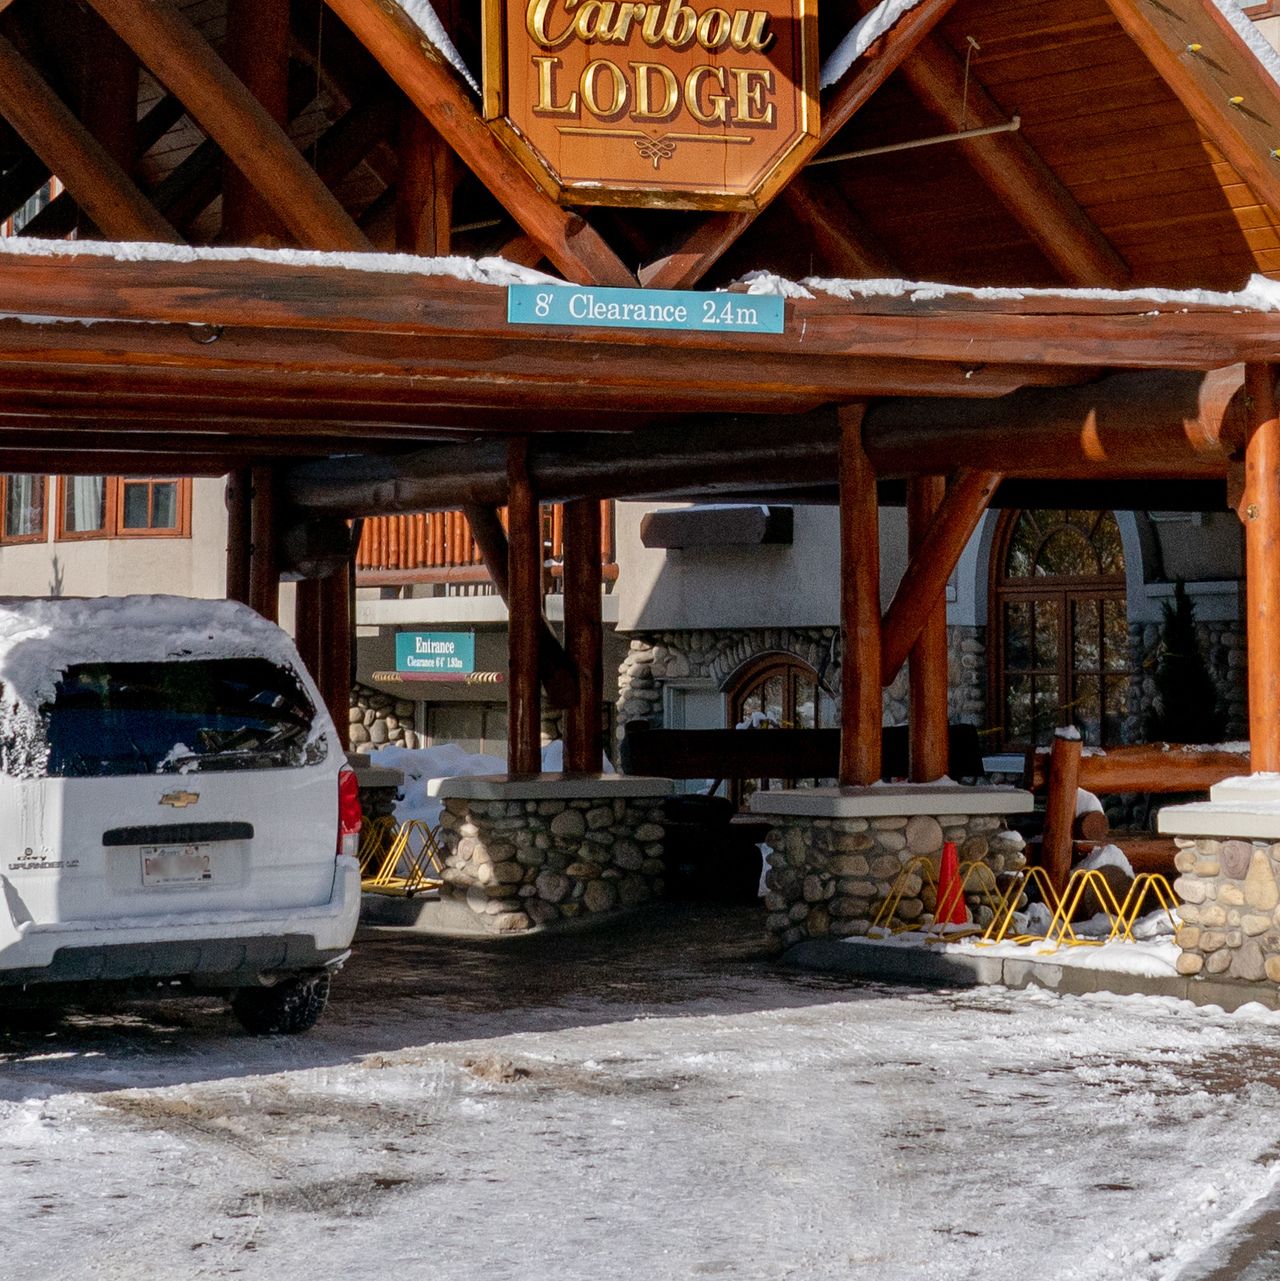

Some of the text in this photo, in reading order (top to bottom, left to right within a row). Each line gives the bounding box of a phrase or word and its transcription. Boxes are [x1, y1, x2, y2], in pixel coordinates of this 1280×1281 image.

[532, 56, 773, 124] LODGE
[535, 293, 758, 325] 8' Clearance 2.4m
[415, 636, 455, 654] Entrance
[407, 656, 434, 667] Clearance
